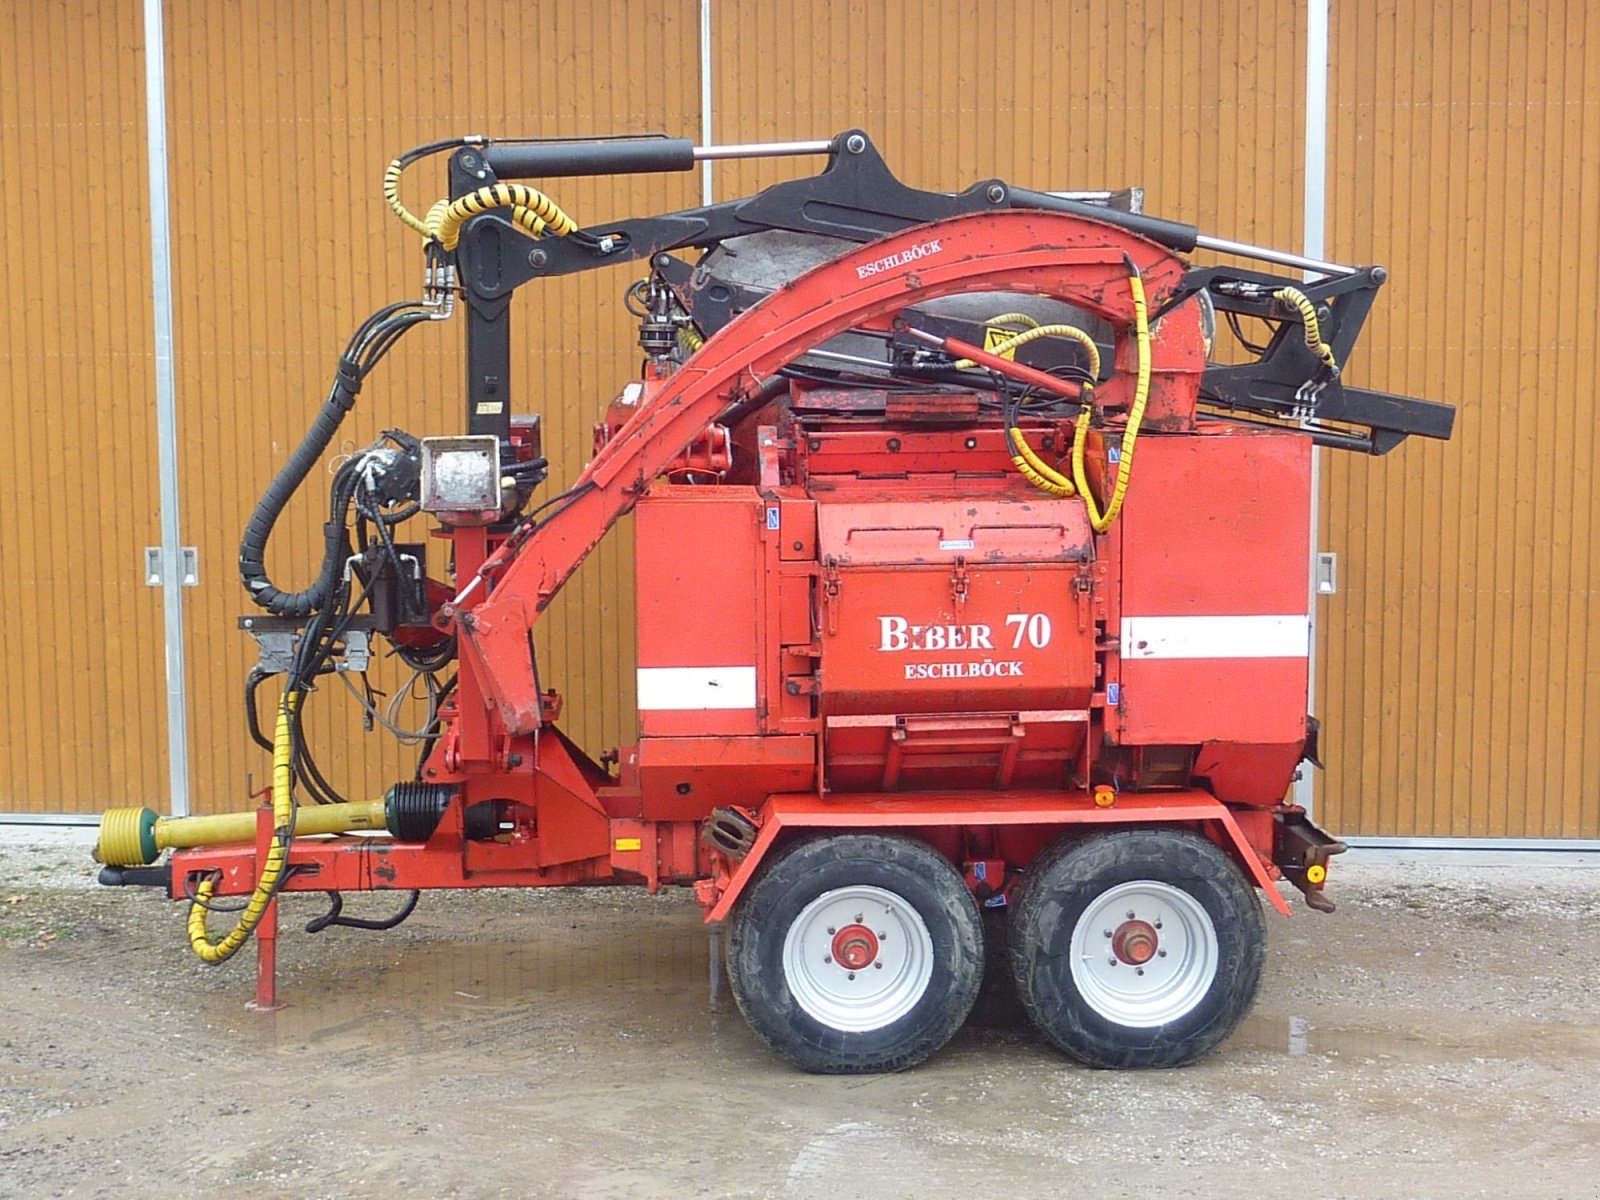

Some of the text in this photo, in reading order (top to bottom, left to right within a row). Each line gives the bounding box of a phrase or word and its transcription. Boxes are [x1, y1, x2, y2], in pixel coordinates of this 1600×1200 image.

[856, 239, 943, 280] ESCHLBÖCK
[1005, 613, 1051, 649] 70
[904, 659, 1024, 679] ESCHLBÖCK
